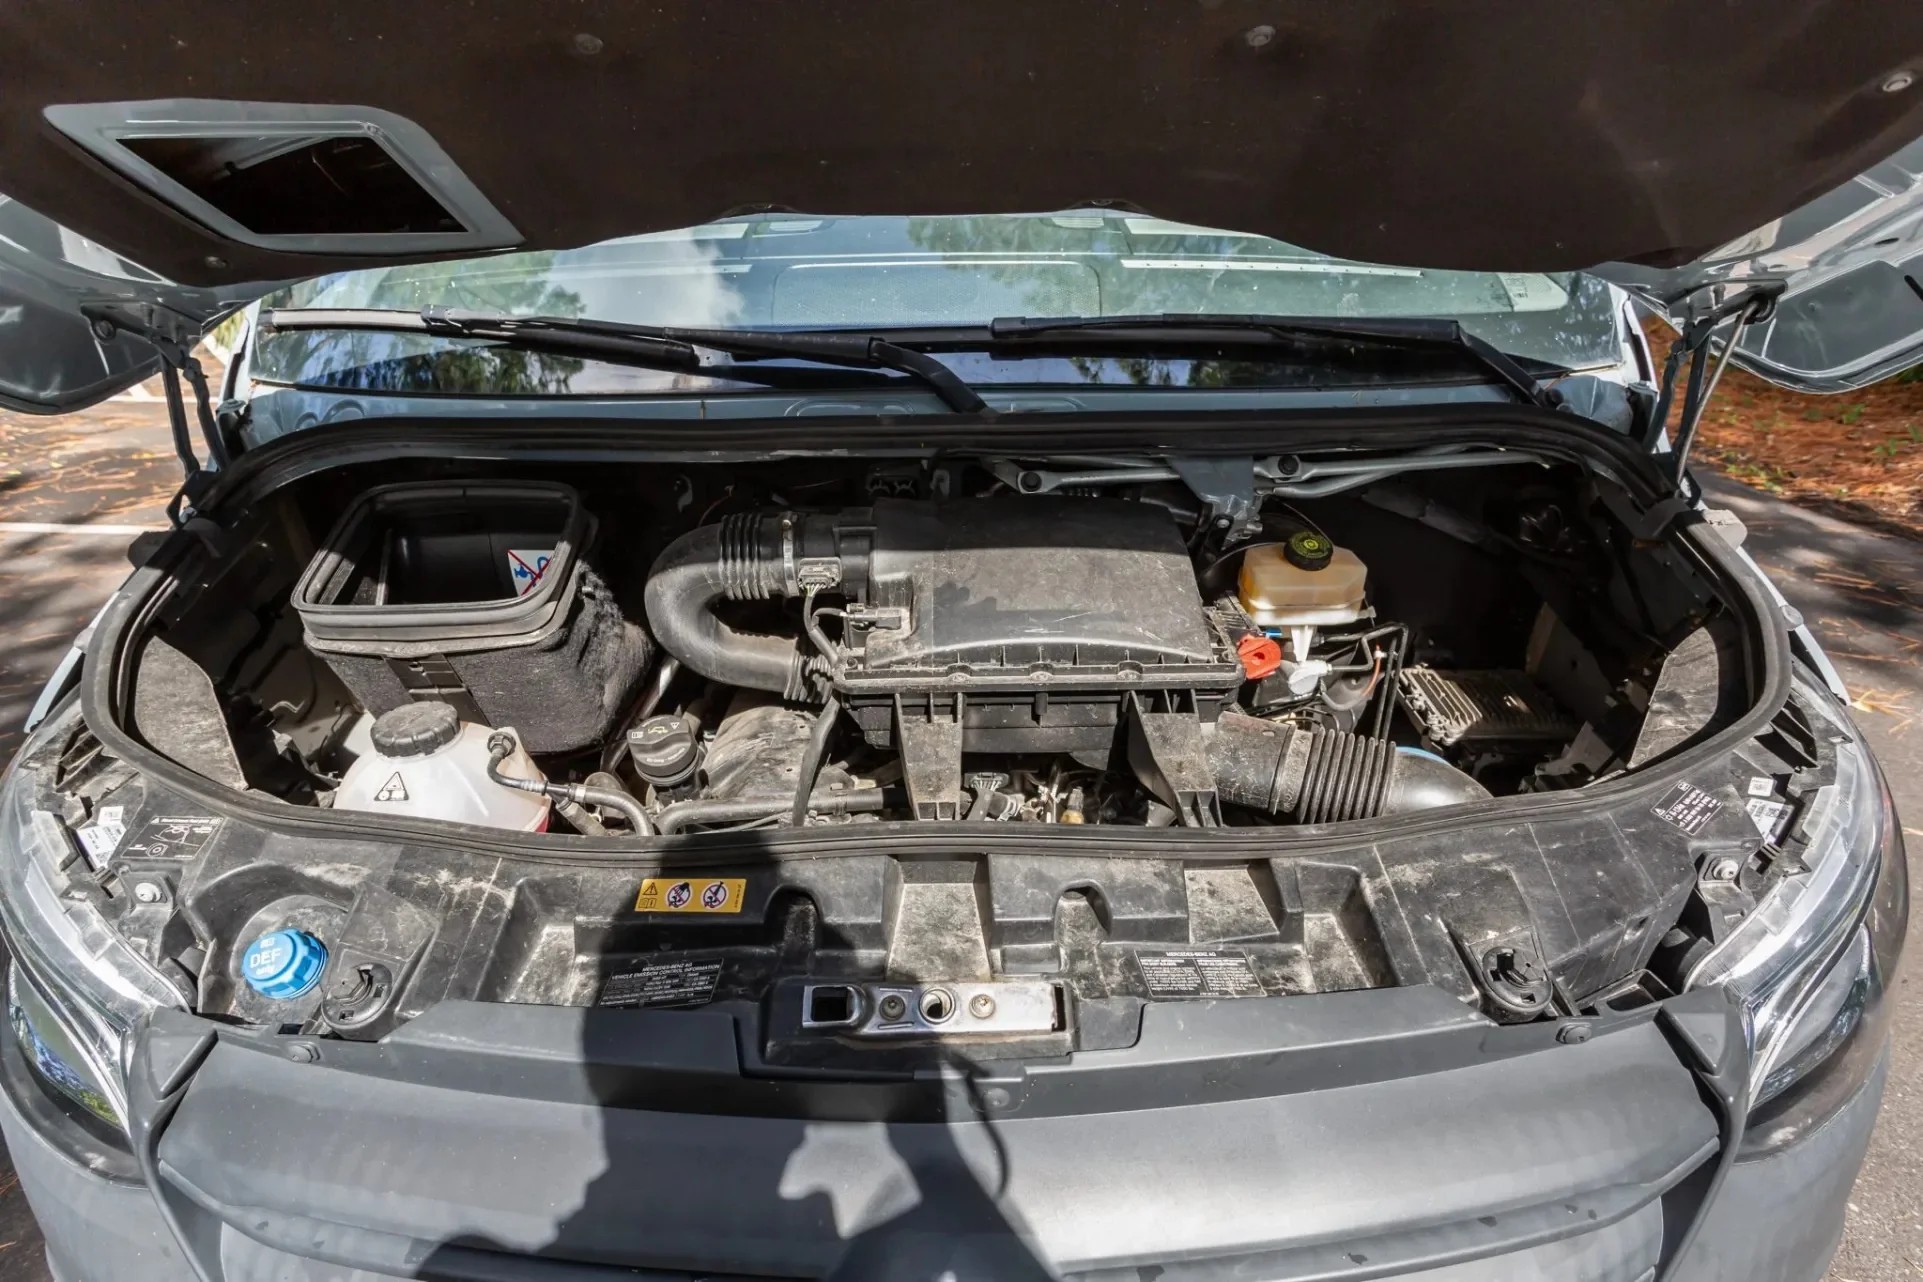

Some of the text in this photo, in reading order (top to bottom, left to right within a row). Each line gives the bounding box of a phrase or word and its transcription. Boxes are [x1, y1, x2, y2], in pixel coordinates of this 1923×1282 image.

[250, 948, 282, 968] DEF
[256, 965, 276, 976] only
[642, 963, 685, 972] MERCEDES-BENZ
[658, 968, 683, 976] CONTROL
[684, 964, 720, 972] INFORMATION
